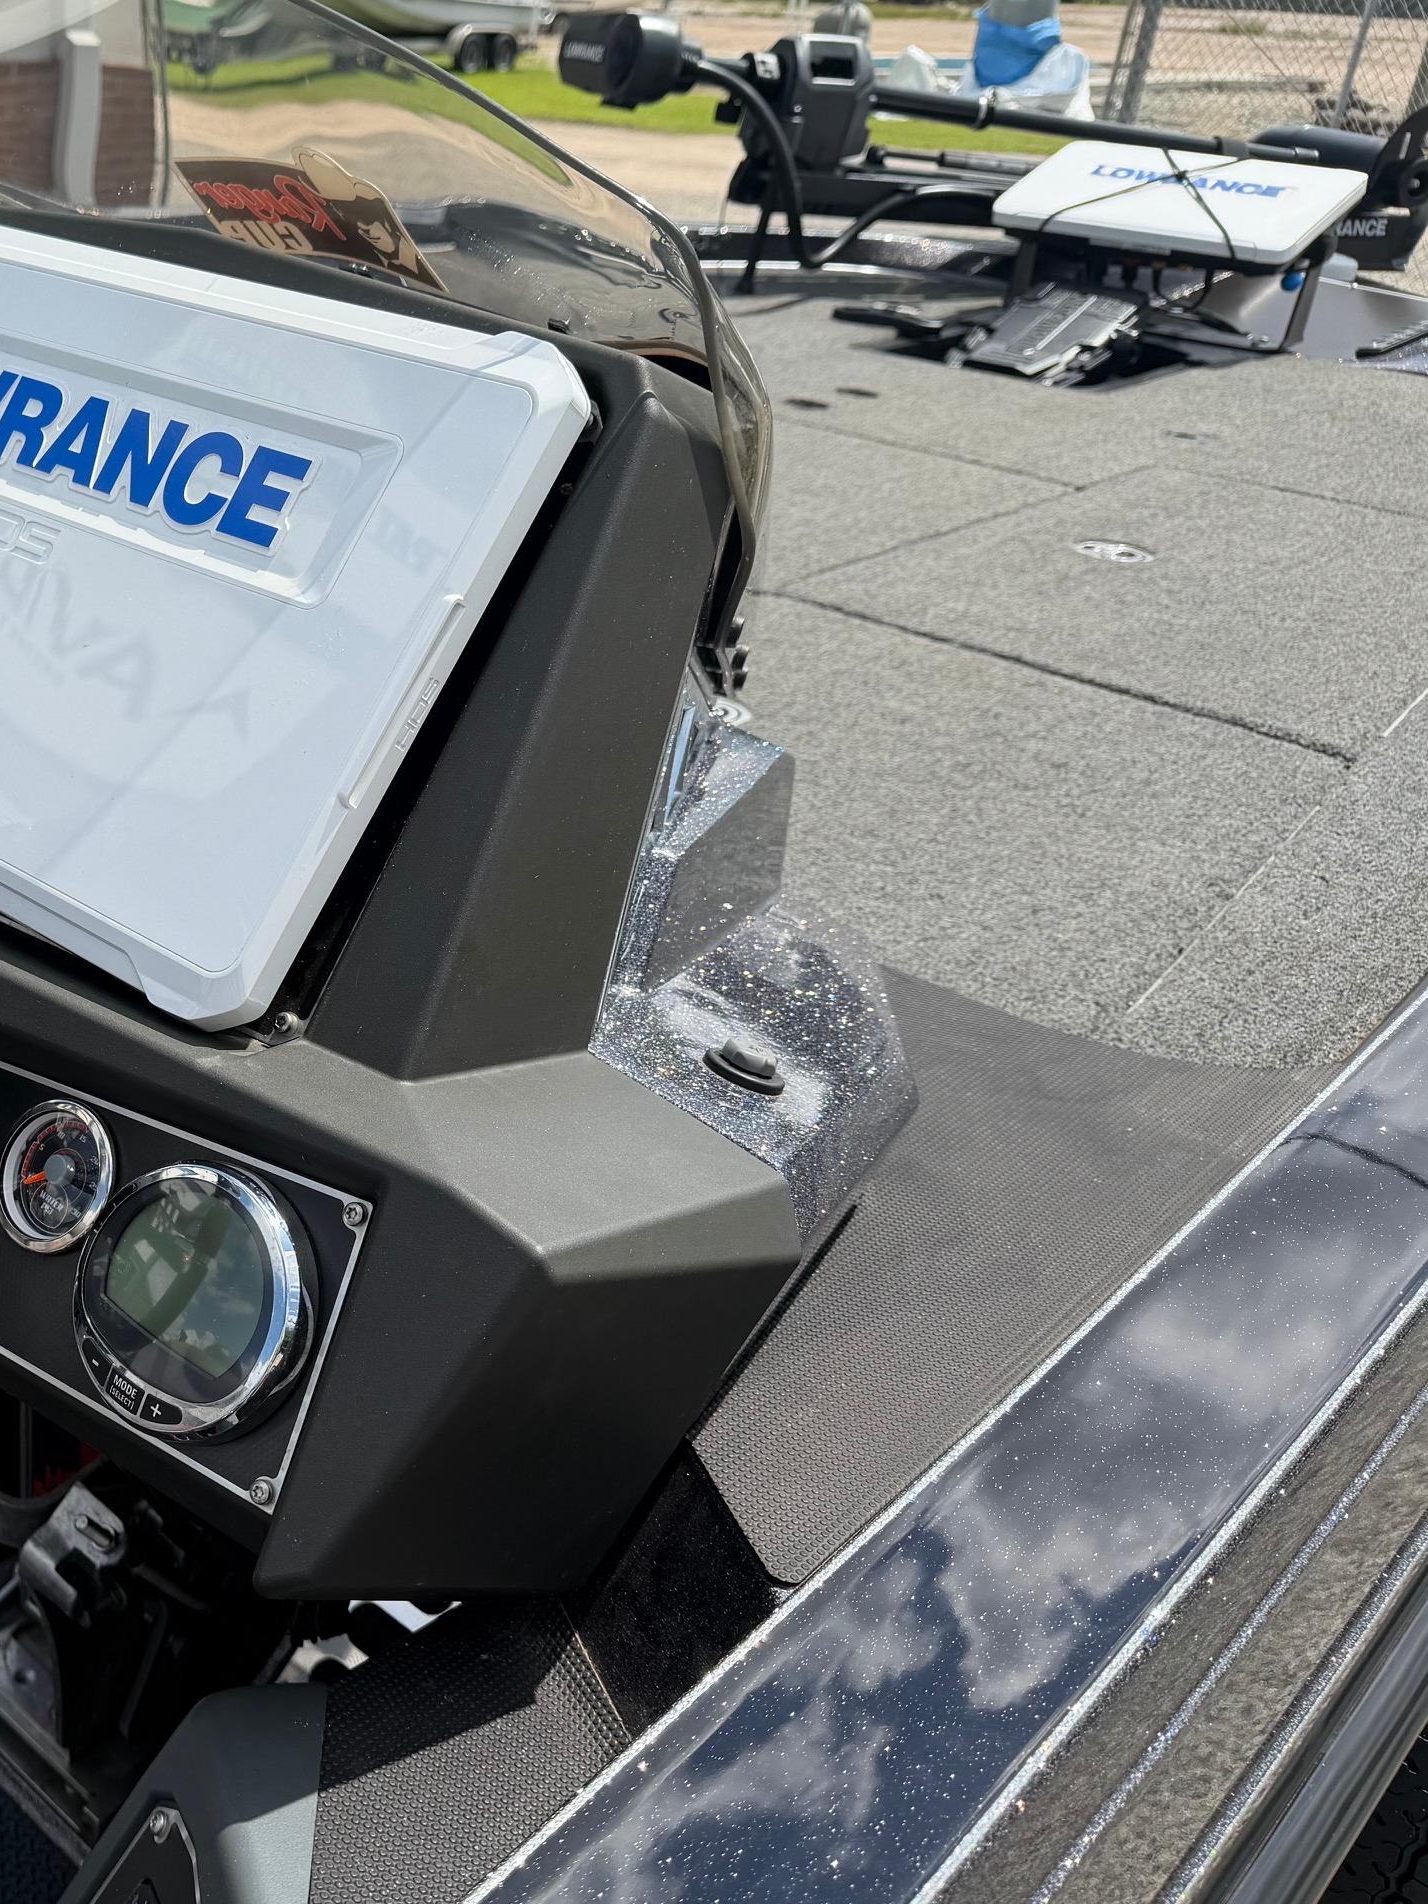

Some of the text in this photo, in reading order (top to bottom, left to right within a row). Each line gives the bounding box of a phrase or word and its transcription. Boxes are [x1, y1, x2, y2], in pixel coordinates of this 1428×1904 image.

[394, 677, 440, 752] HDS
[56, 1131, 67, 1140] 10
[79, 1134, 88, 1143] 15
[38, 1142, 47, 1151] 5
[39, 1190, 64, 1212] WATER
[40, 1202, 55, 1216] PSI
[71, 1207, 82, 1219] 30
[113, 1374, 138, 1400] MODE
